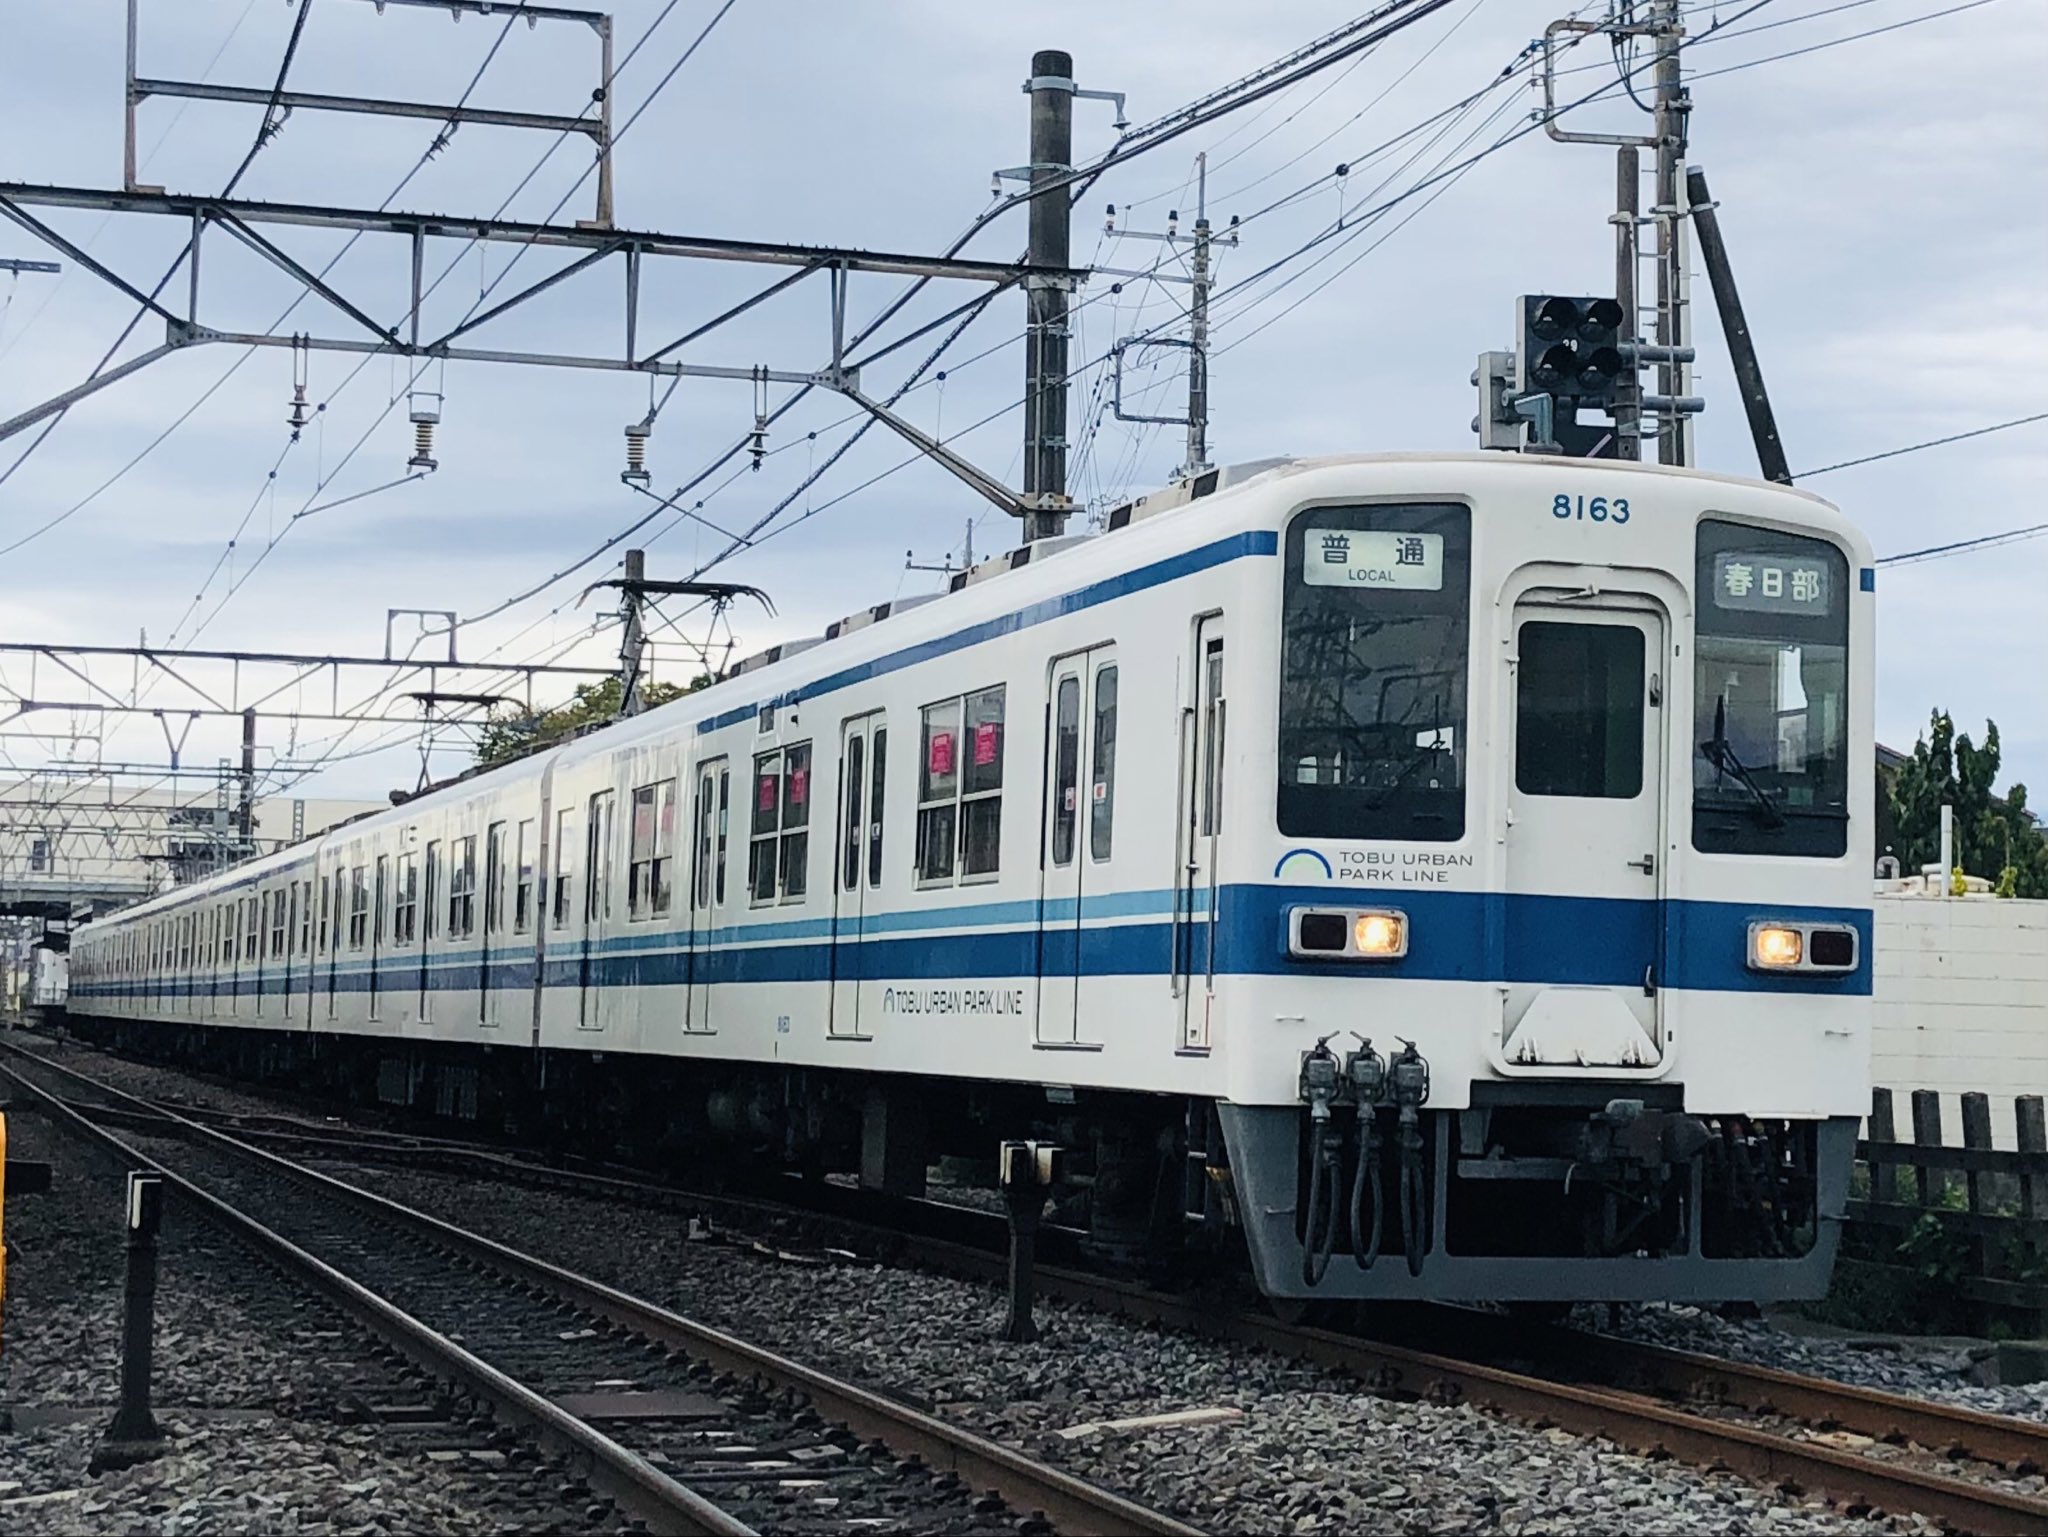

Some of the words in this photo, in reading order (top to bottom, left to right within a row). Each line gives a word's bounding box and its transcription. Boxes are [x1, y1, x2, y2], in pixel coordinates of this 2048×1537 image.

[1552, 494, 1630, 524] 8163
[1321, 533, 1425, 566] 普通
[1348, 569, 1396, 582] LOCAL
[1724, 563, 1820, 603] 春日部
[1339, 851, 1395, 865] TOBU
[1402, 854, 1473, 866] URBAN
[1339, 869, 1394, 881] PARK
[1402, 871, 1449, 882] LINE
[896, 990, 922, 1014] TOBU
[924, 990, 962, 1014] URBAN
[964, 990, 994, 1014] PARK
[996, 990, 1023, 1014] LINE
